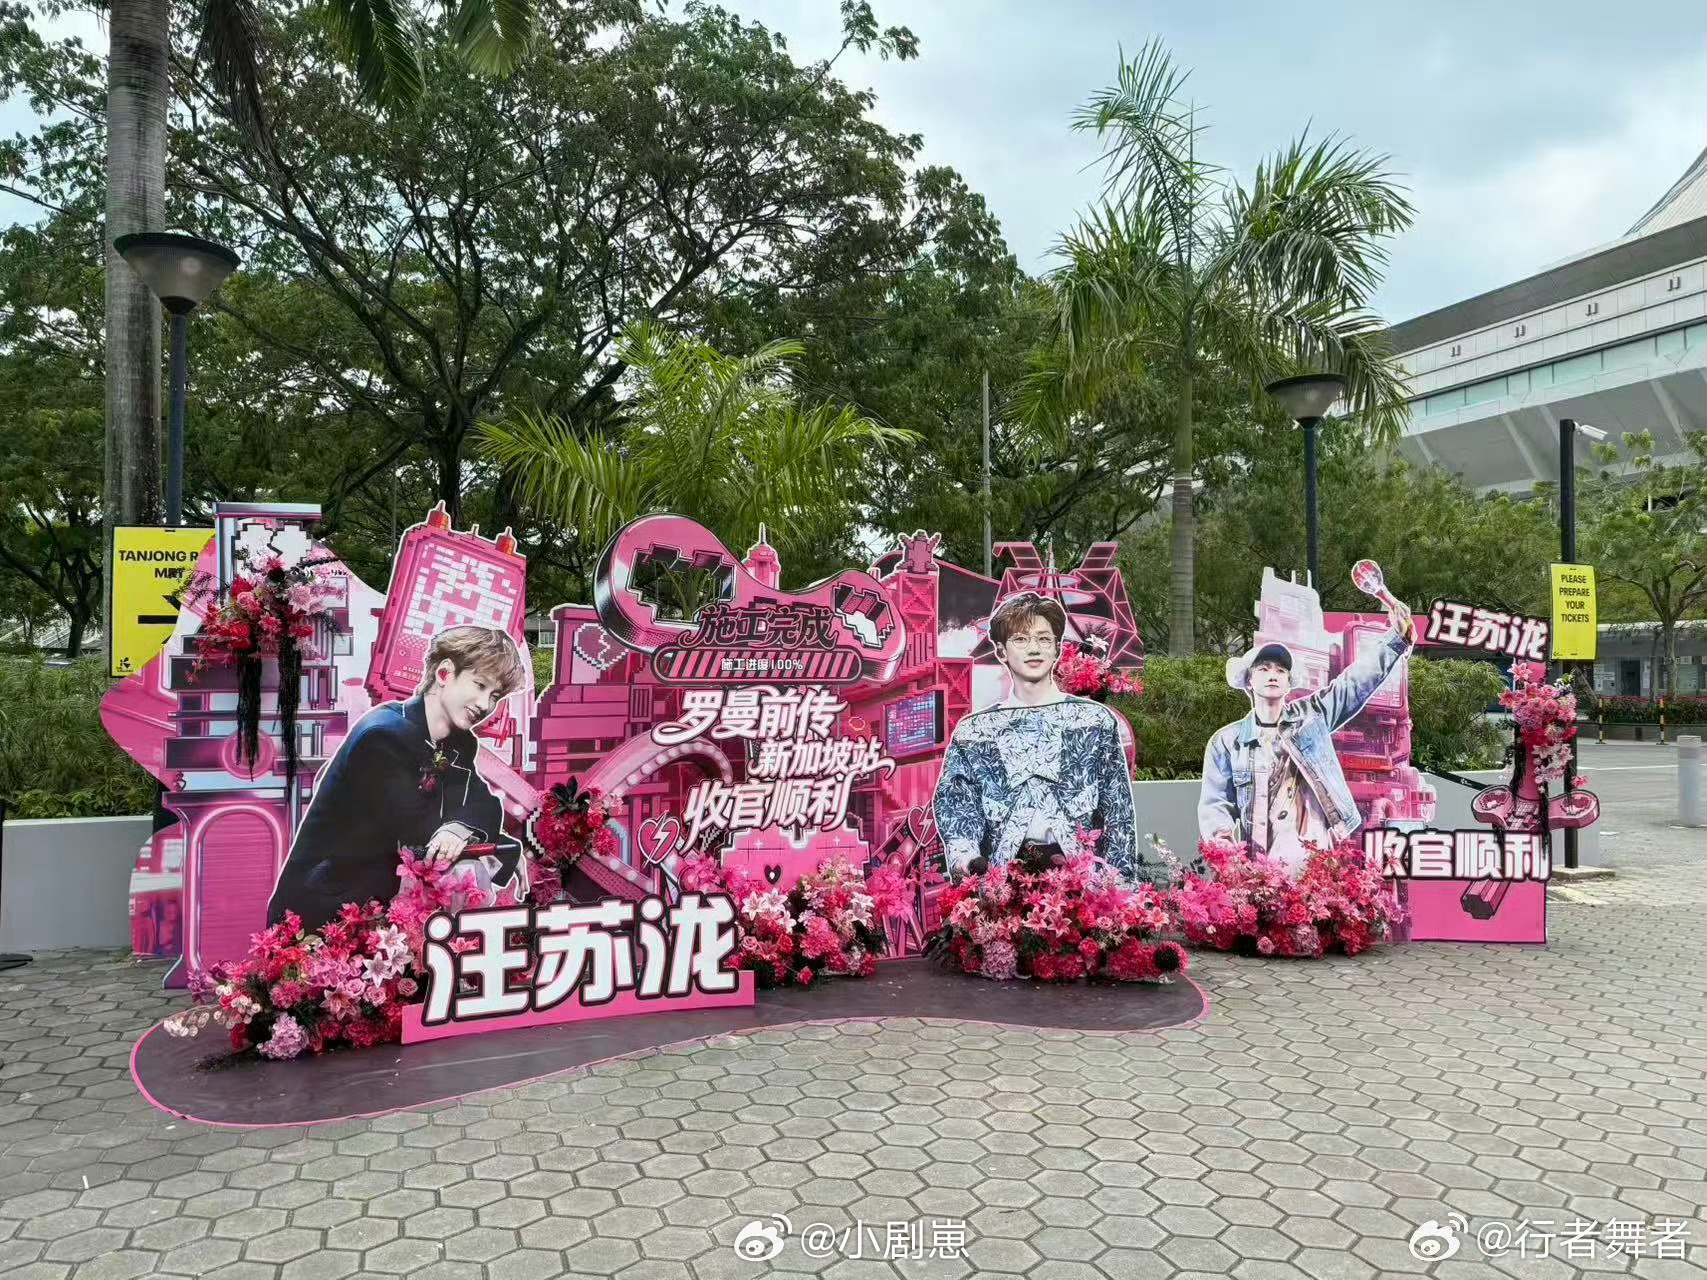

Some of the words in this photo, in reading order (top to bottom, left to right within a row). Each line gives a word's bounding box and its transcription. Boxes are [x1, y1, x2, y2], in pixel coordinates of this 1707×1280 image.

[119, 550, 187, 562] TANJONG
[190, 550, 199, 562] R
[154, 567, 184, 579] MRT
[1561, 574, 1587, 584] PLEASE
[1559, 587, 1590, 597] PREPARE
[1566, 600, 1585, 610] YOUR
[678, 604, 838, 649] 施工完成
[1426, 600, 1549, 661] 汪苏泷
[1561, 613, 1590, 623] TICKETS
[720, 657, 804, 672] 施工进度100%
[652, 686, 848, 745] 罗曼前传
[747, 736, 896, 780] 新加坡站
[680, 774, 856, 856] 收官顺利
[1364, 830, 1550, 881] 收官顺利
[424, 895, 738, 1023] 汪苏泷
